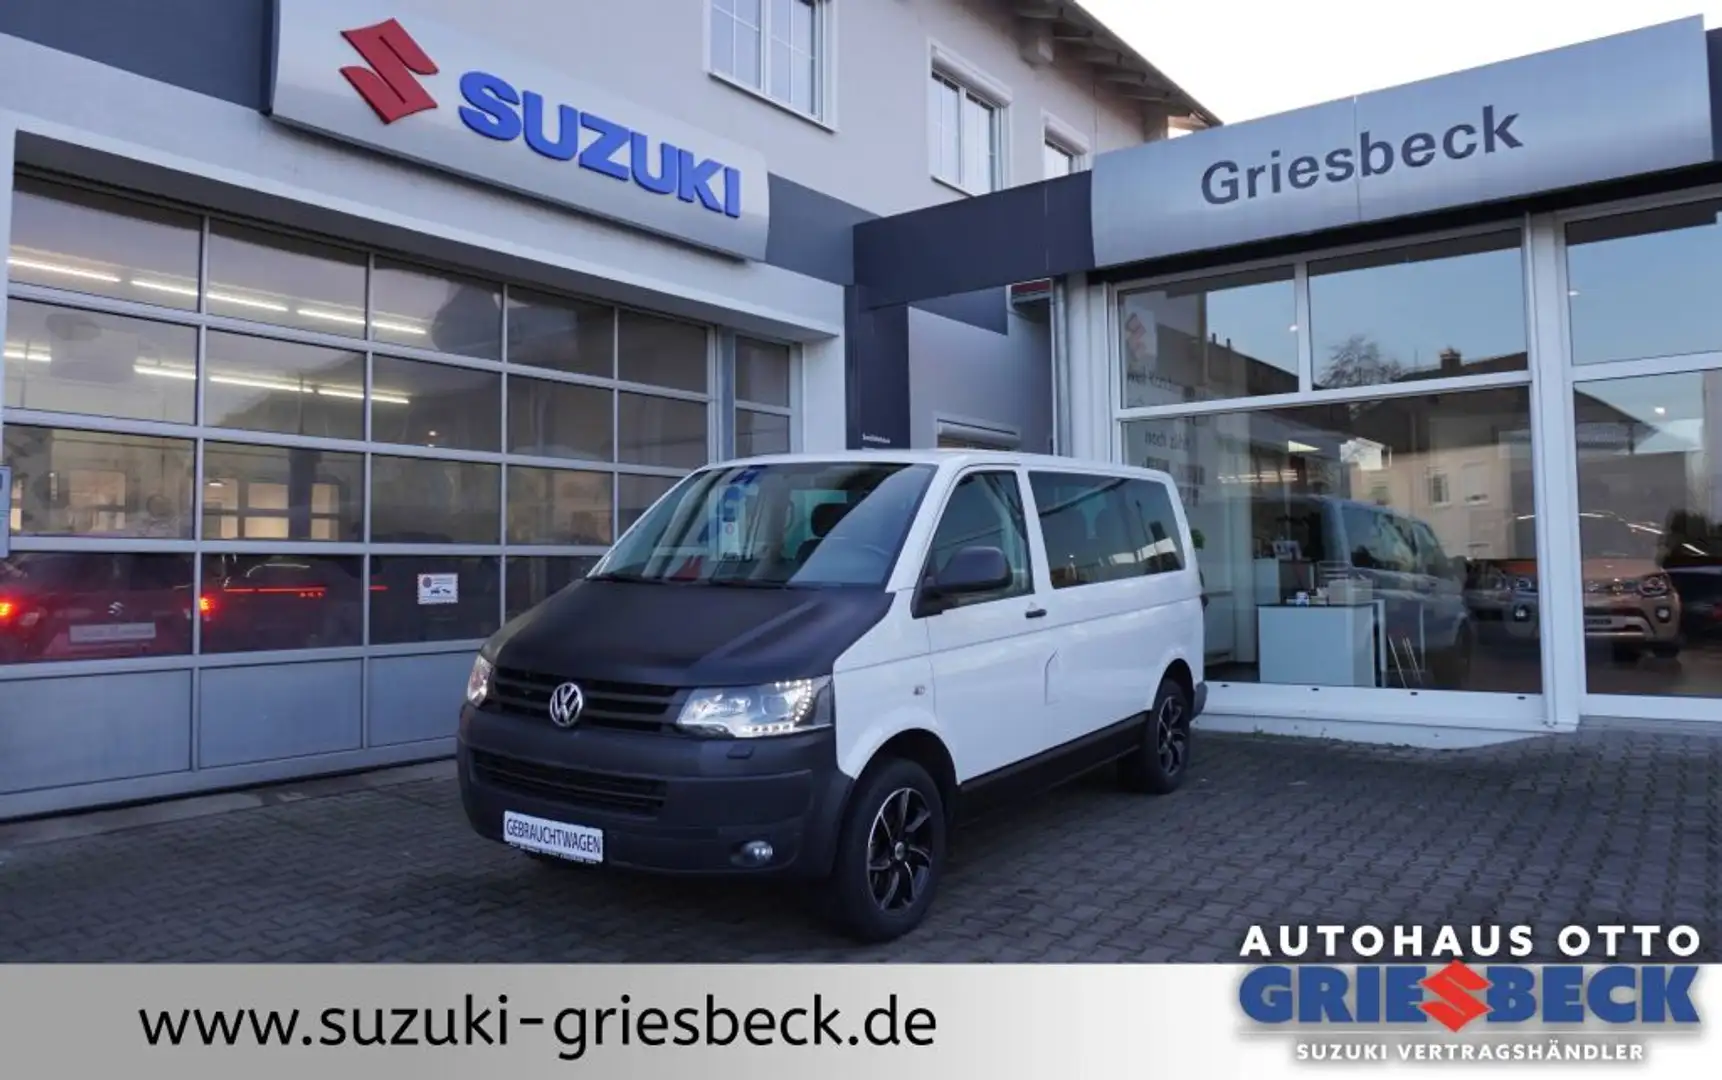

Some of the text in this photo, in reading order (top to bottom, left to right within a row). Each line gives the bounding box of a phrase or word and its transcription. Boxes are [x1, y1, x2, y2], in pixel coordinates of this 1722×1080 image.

[458, 71, 741, 219] SUZUKI
[1201, 104, 1524, 205] Griesbeck
[506, 818, 601, 854] GEBRAUCHTWAGEN
